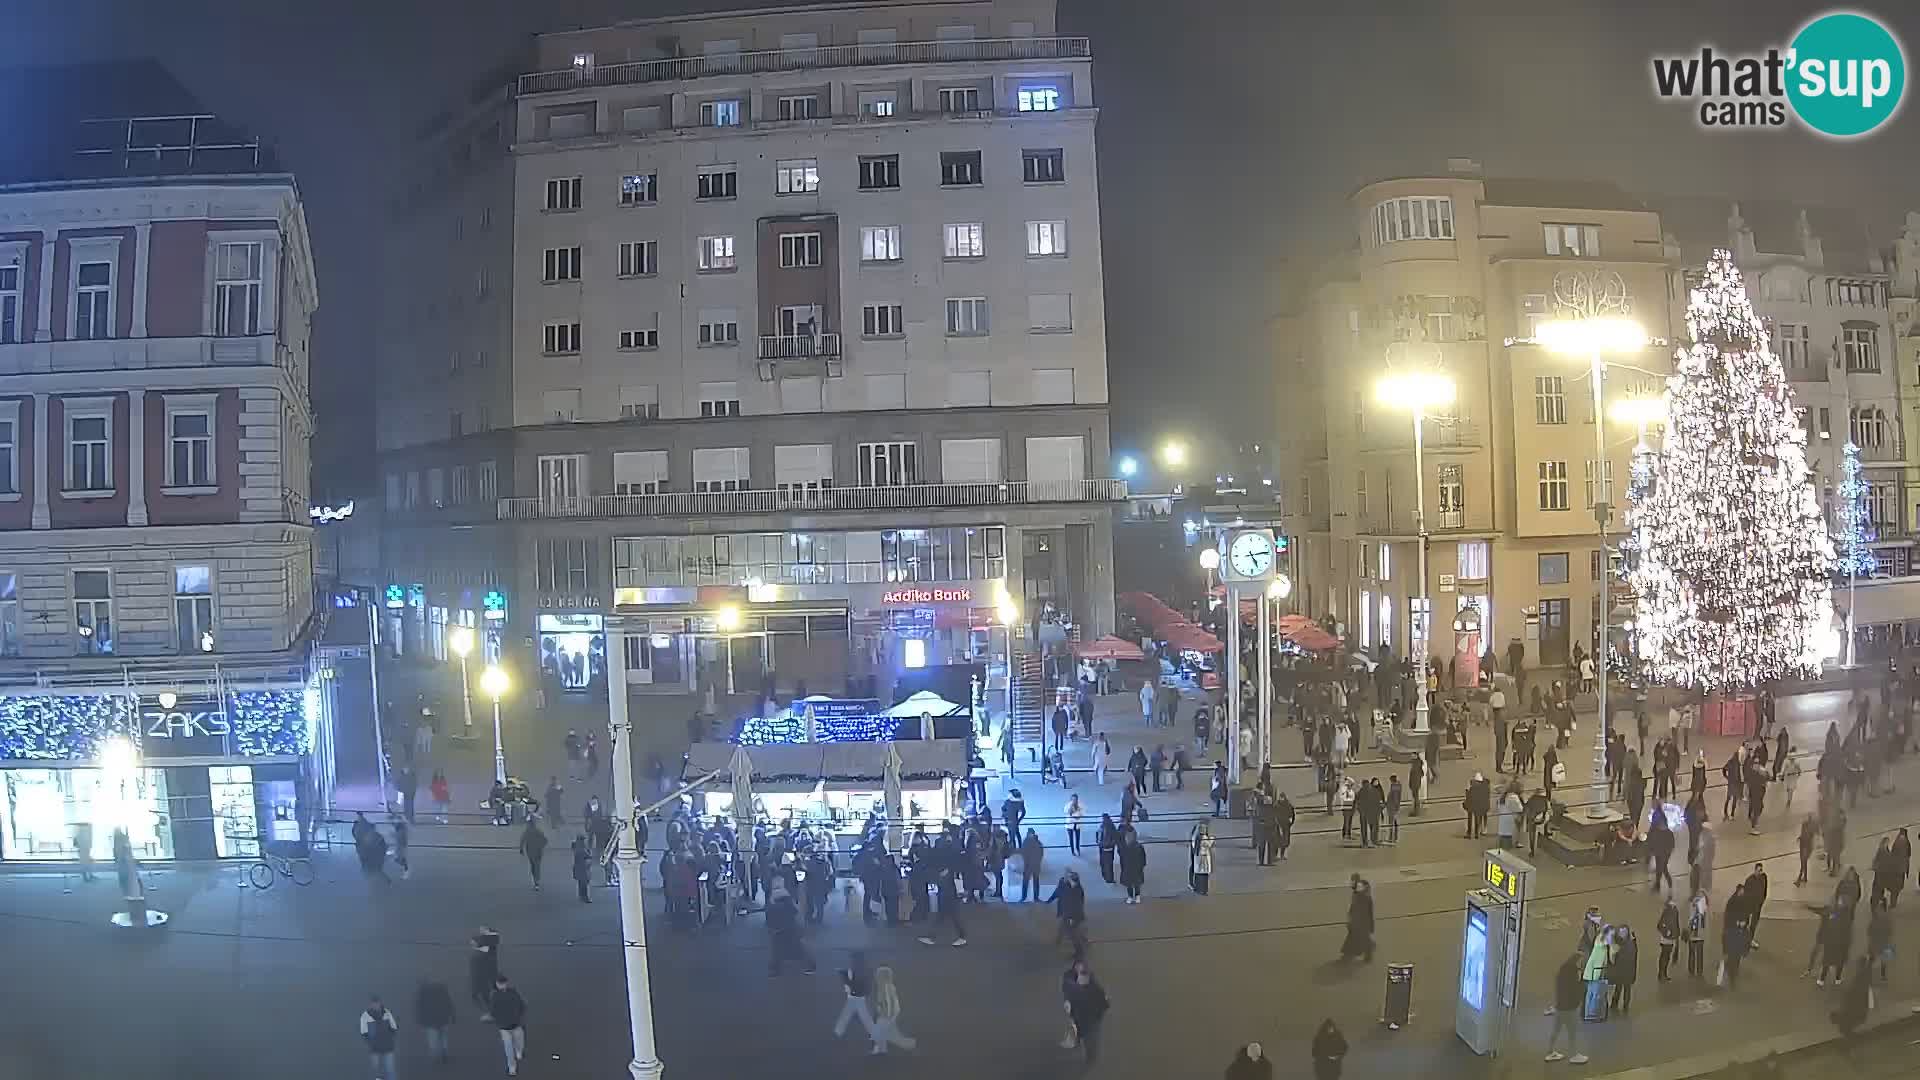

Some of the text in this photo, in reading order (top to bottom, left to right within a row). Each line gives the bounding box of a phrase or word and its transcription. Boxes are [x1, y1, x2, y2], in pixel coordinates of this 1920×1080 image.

[883, 588, 970, 603] Addiko Bank
[143, 712, 231, 738] ZAKS
